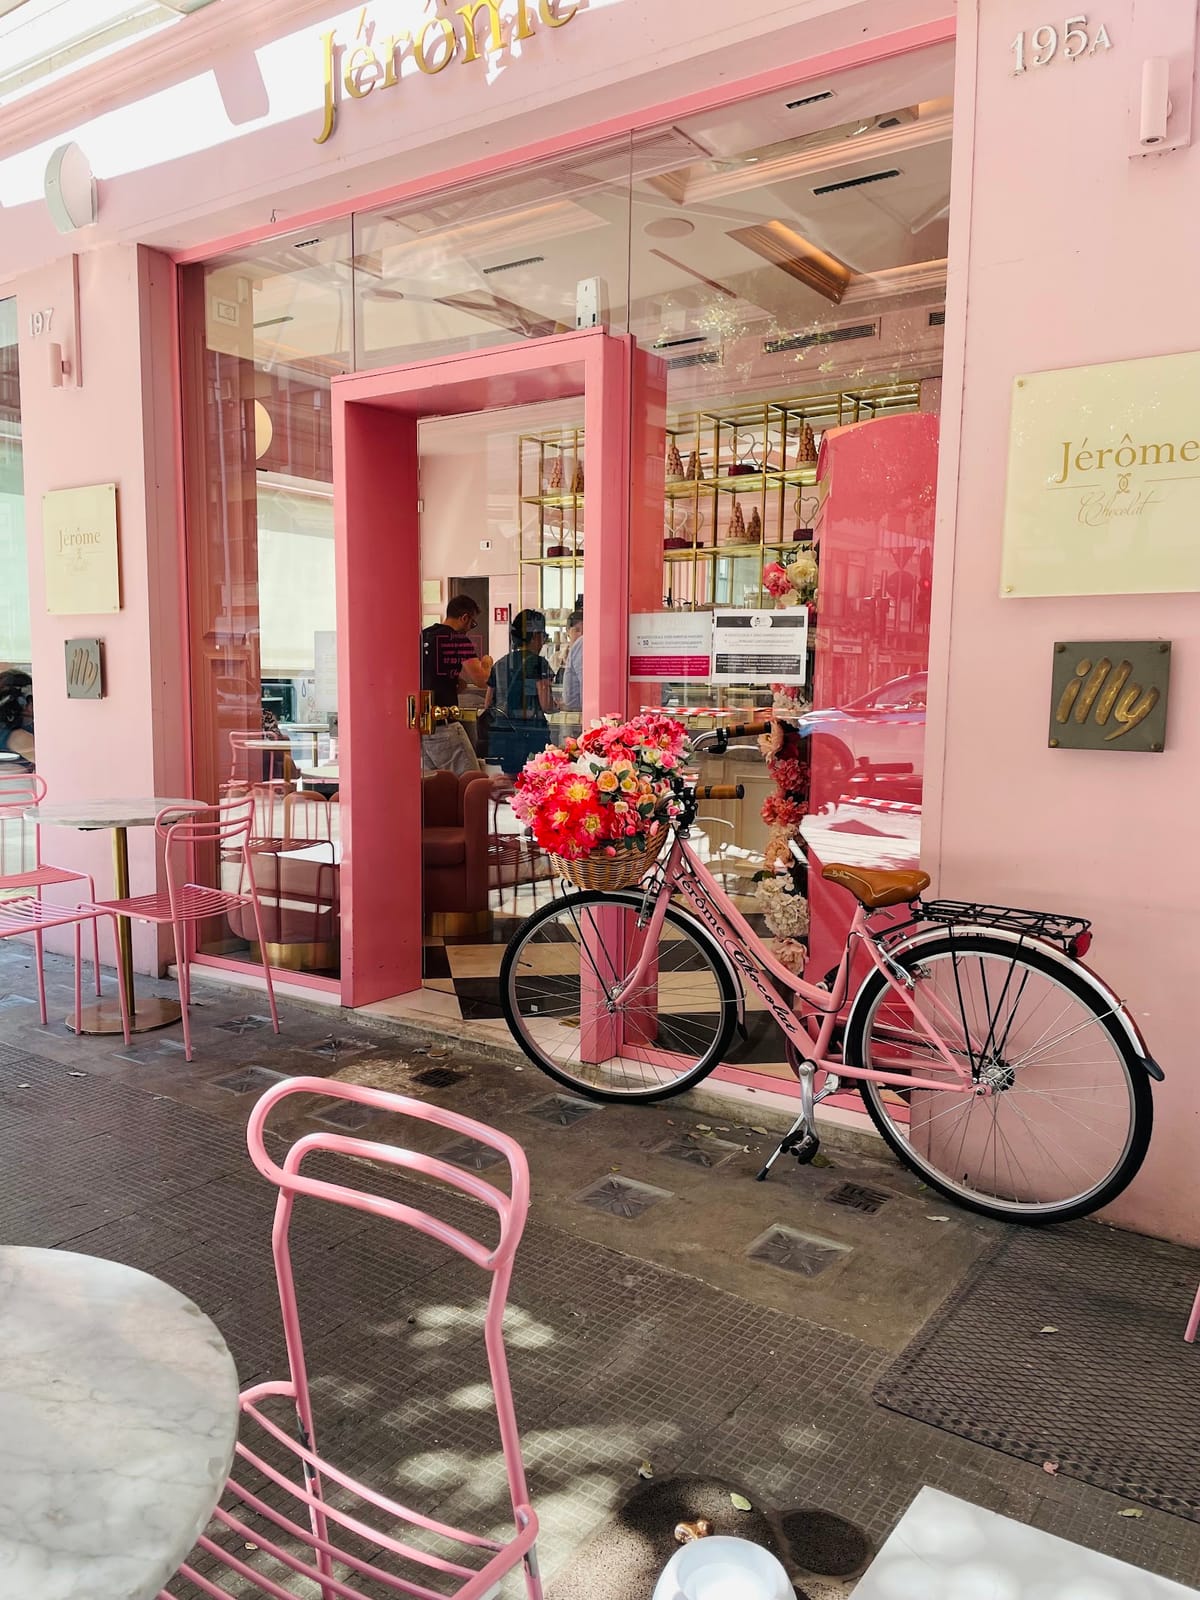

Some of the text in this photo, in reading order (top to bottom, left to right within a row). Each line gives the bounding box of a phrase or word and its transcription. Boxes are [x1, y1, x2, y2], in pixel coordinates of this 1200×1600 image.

[1008, 15, 1114, 76] 195A
[29, 307, 55, 336] 197
[1055, 433, 1200, 484] Jérôme
[68, 647, 99, 694] illy
[1056, 657, 1160, 741] illy
